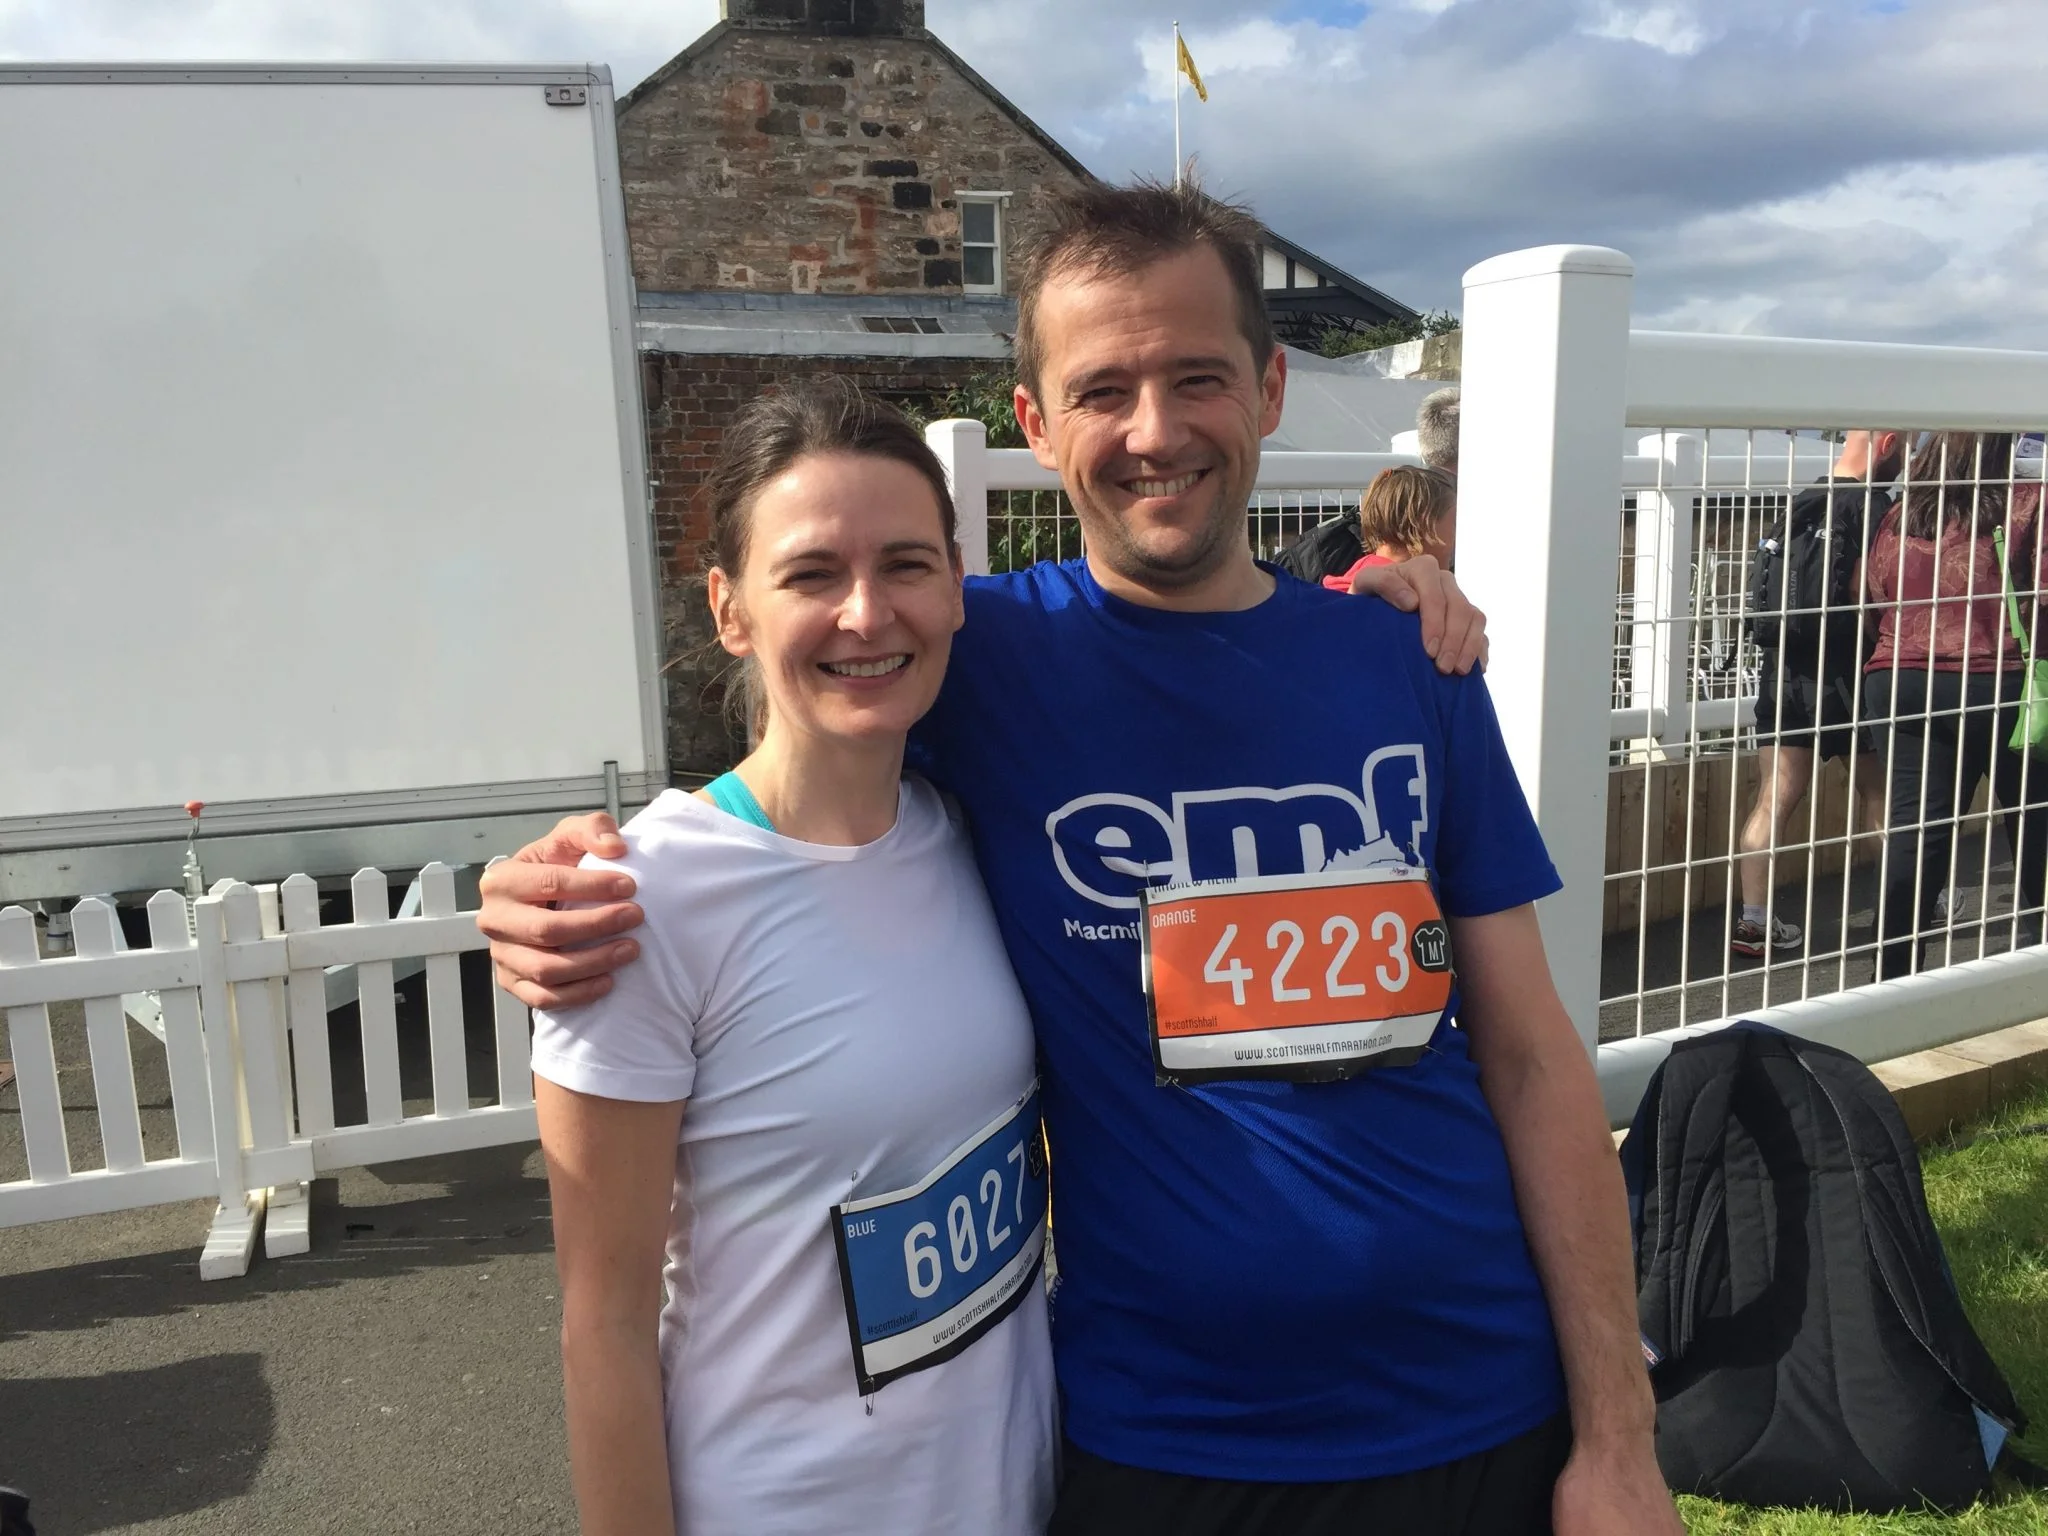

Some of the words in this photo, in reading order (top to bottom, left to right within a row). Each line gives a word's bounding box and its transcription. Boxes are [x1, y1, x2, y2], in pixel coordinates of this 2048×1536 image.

[1152, 908, 1197, 928] ORANGE
[1203, 911, 1410, 1006] 4223
[1428, 940, 1440, 961] M
[1165, 1016, 1218, 1031] #scottishhalf
[847, 1219, 877, 1239] BLUE
[904, 1139, 1025, 1299] 6027
